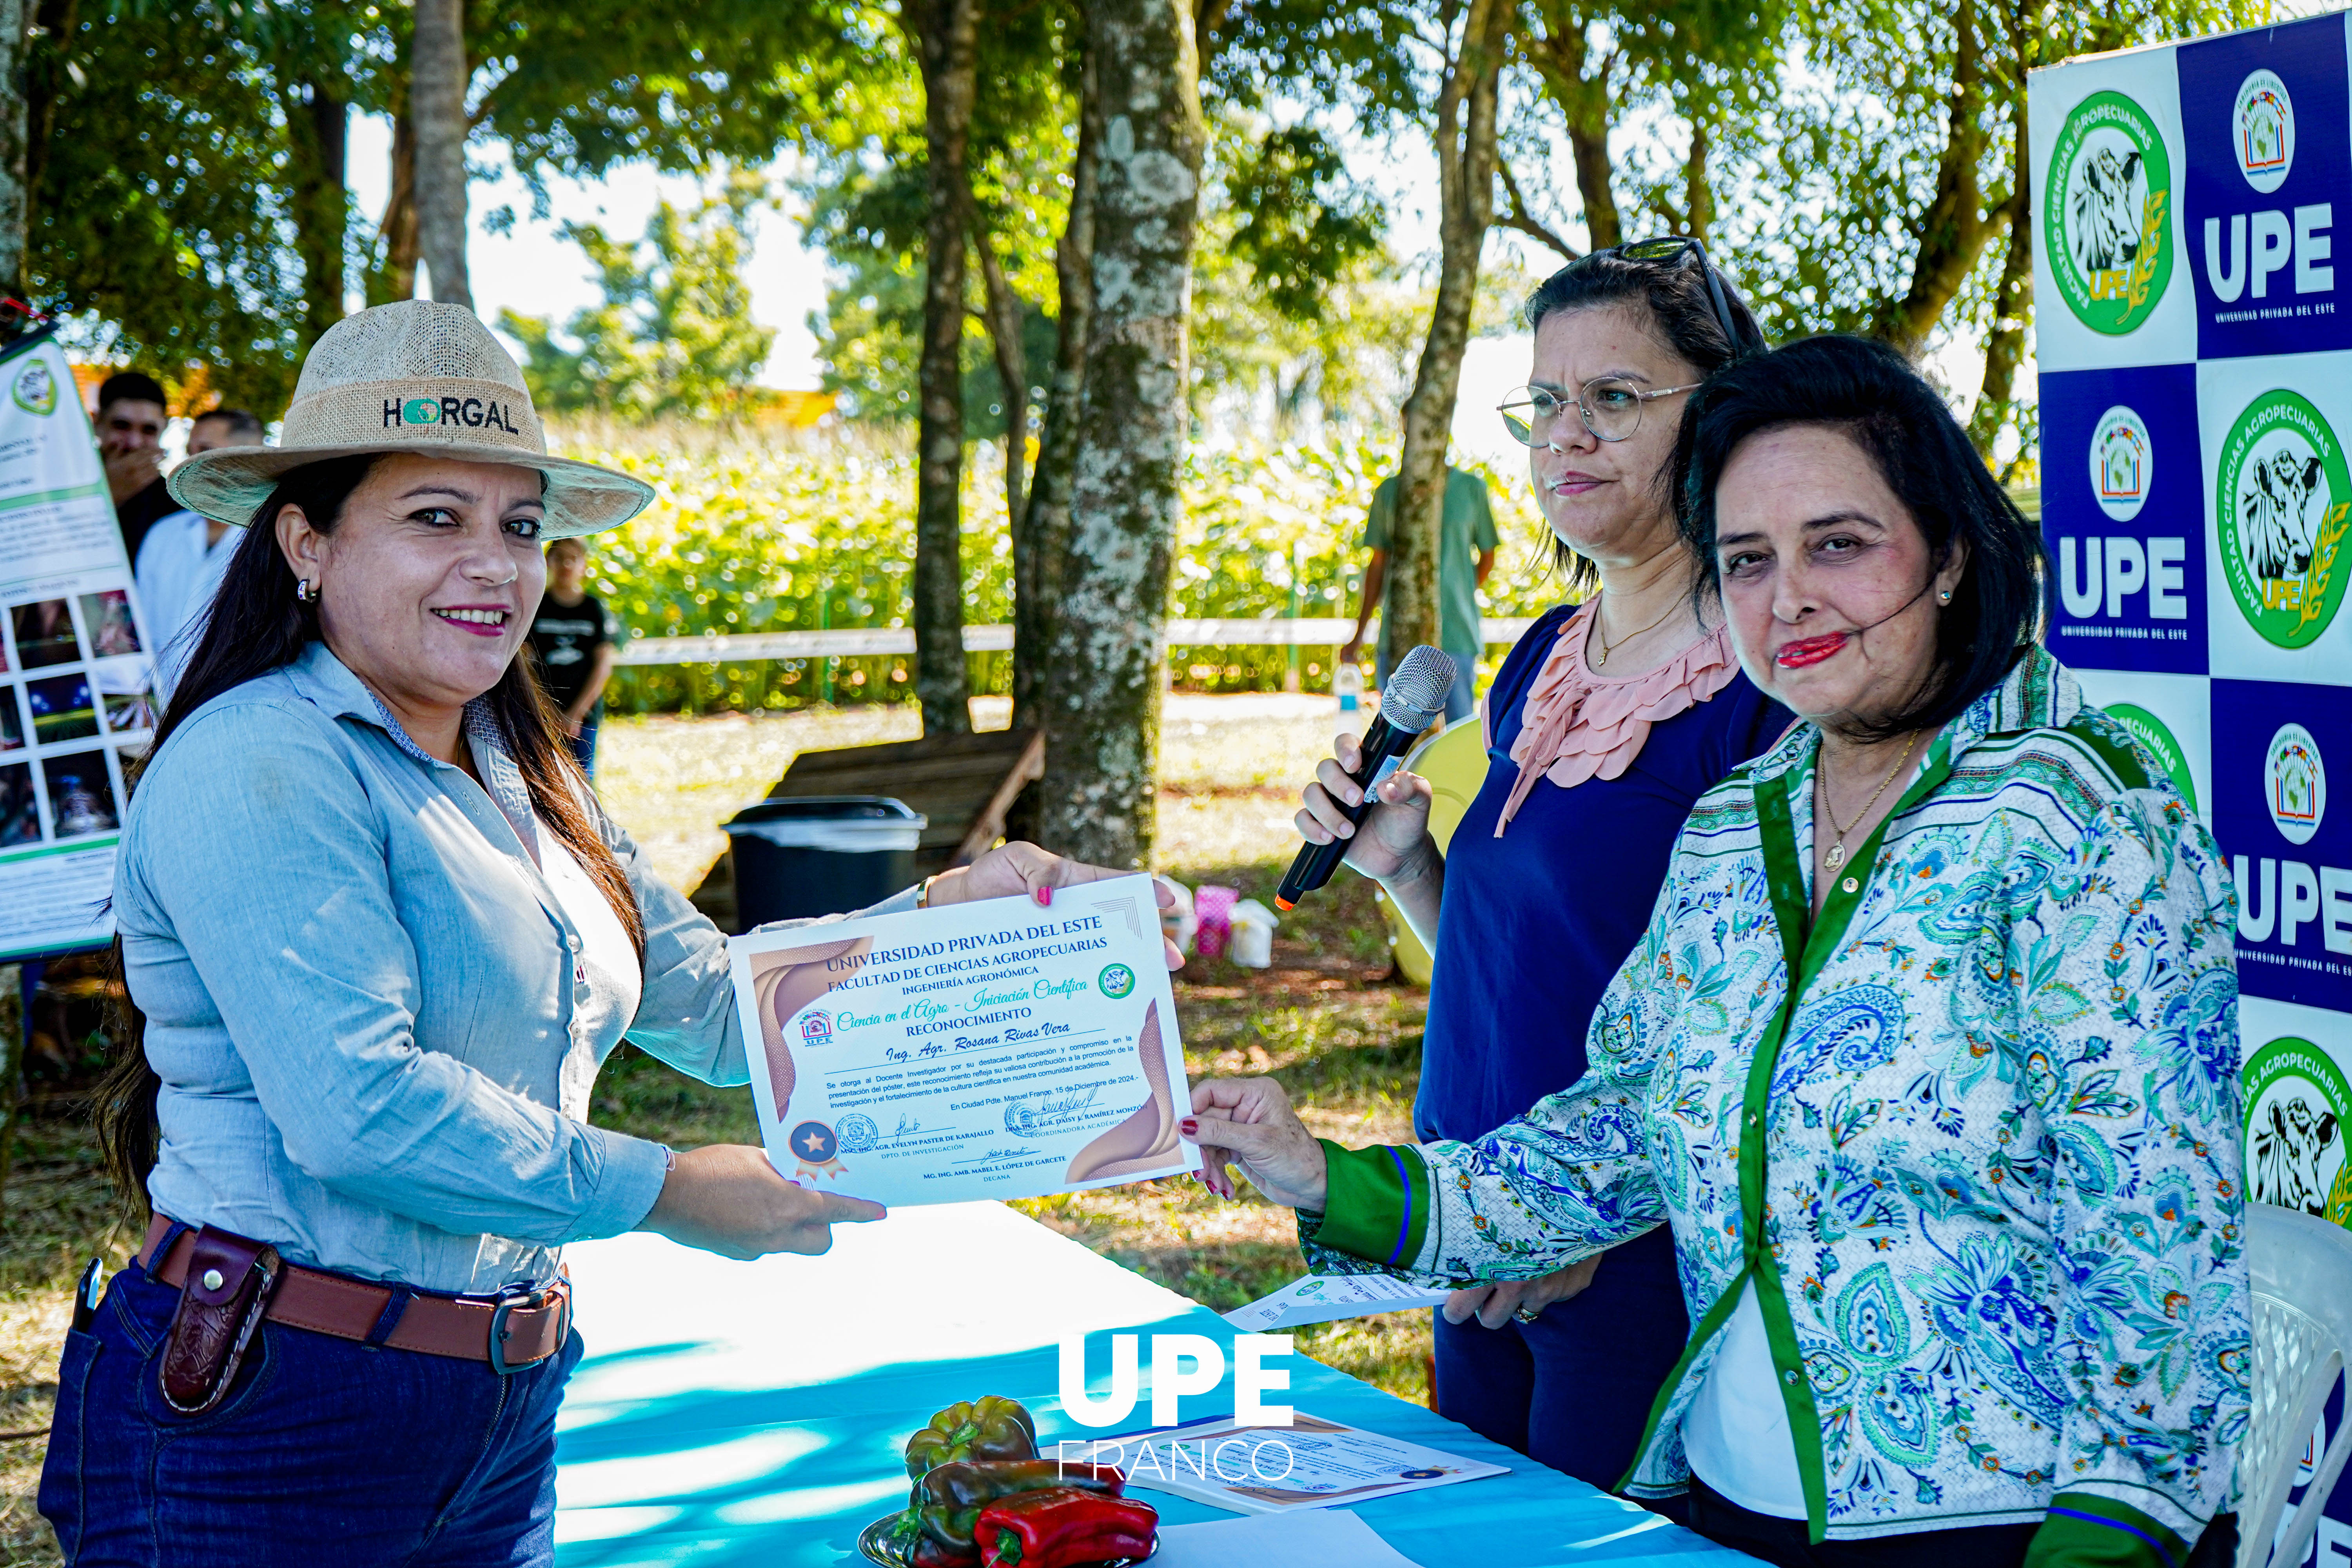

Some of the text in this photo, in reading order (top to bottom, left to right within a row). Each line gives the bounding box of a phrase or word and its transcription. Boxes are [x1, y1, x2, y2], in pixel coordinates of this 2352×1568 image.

[2052, 104, 2152, 309] FACULTAD CIENCIAS AGROPECUARIAS
[2204, 202, 2334, 303] UPE
[2090, 269, 2128, 301] UPE
[2215, 303, 2335, 323] UNIVERSIDAD PRIVADA DEL ESTE
[383, 397, 519, 435] HORGAL
[2224, 403, 2330, 618] FACULTAD CIENCIAS AGROPECUARIAS
[2059, 537, 2187, 619] UPE
[2262, 579, 2300, 610] UPE
[2061, 625, 2187, 640] UNIVERSIDAD PRIVADA DEL ESTE
[2118, 717, 2177, 773] PECUARIAS
[2234, 854, 2352, 955] UPE
[826, 915, 1102, 971] UNIVERSIDAD PRIVADA DEL ESTE
[2234, 948, 2352, 976] UNIVERSIDAD PRIVADA DEL ES
[828, 937, 1107, 992] FACULTAD DE CIENCIAS AGROPECUARIAS
[902, 966, 1039, 995] INGENIERÍA AGRONÓMICA
[837, 1011, 882, 1031] Ciencia
[884, 1013, 898, 1022] en
[900, 1004, 911, 1020] el
[913, 998, 949, 1021] Agro
[964, 987, 1030, 1012] Iniciación
[906, 1007, 1031, 1036] RECONOCIMIENTO
[875, 1073, 903, 1082] Docente
[907, 1066, 946, 1077] Investigador
[978, 1055, 1012, 1066] destacada
[1016, 1048, 1056, 1061] participación
[1069, 1040, 1109, 1051] compromiso
[886, 1022, 1070, 1063] Ing. Agr. Rosana Rivas Vera
[828, 1088, 869, 1100] presentación
[882, 1083, 905, 1093] póster,
[922, 1073, 971, 1085] reconocimiento
[972, 1069, 992, 1077] refleja
[1028, 1056, 1067, 1068] contribución
[1082, 1048, 1116, 1060] promoción
[830, 1098, 872, 1108] investigación
[885, 1089, 932, 1101] fortalecimiento
[973, 1078, 1002, 1087] científica
[1012, 1072, 1037, 1081] nuestra
[1038, 1065, 1073, 1077] comunidad
[1074, 1060, 1111, 1071] académica.
[2260, 1052, 2348, 1116] AGROPECUARIAS
[961, 1099, 984, 1109] Ciudad
[1004, 1092, 1028, 1102] Manuel
[1075, 1080, 1107, 1091] Diciembre
[1055, 1116, 1075, 1124] DAISY
[1084, 1109, 1115, 1119] RAMÍREZ
[1116, 1102, 1147, 1114] MONZÓN
[891, 1140, 918, 1148] EVELYN
[918, 1136, 944, 1145] PASTER
[955, 1129, 995, 1140] KARAJALLO
[1030, 1125, 1085, 1138] COORDINADORA
[1087, 1119, 1127, 1129] ACADÉMICA
[912, 1143, 964, 1155] INVESTIGACIÓN
[1035, 1155, 1066, 1165] GARCETE
